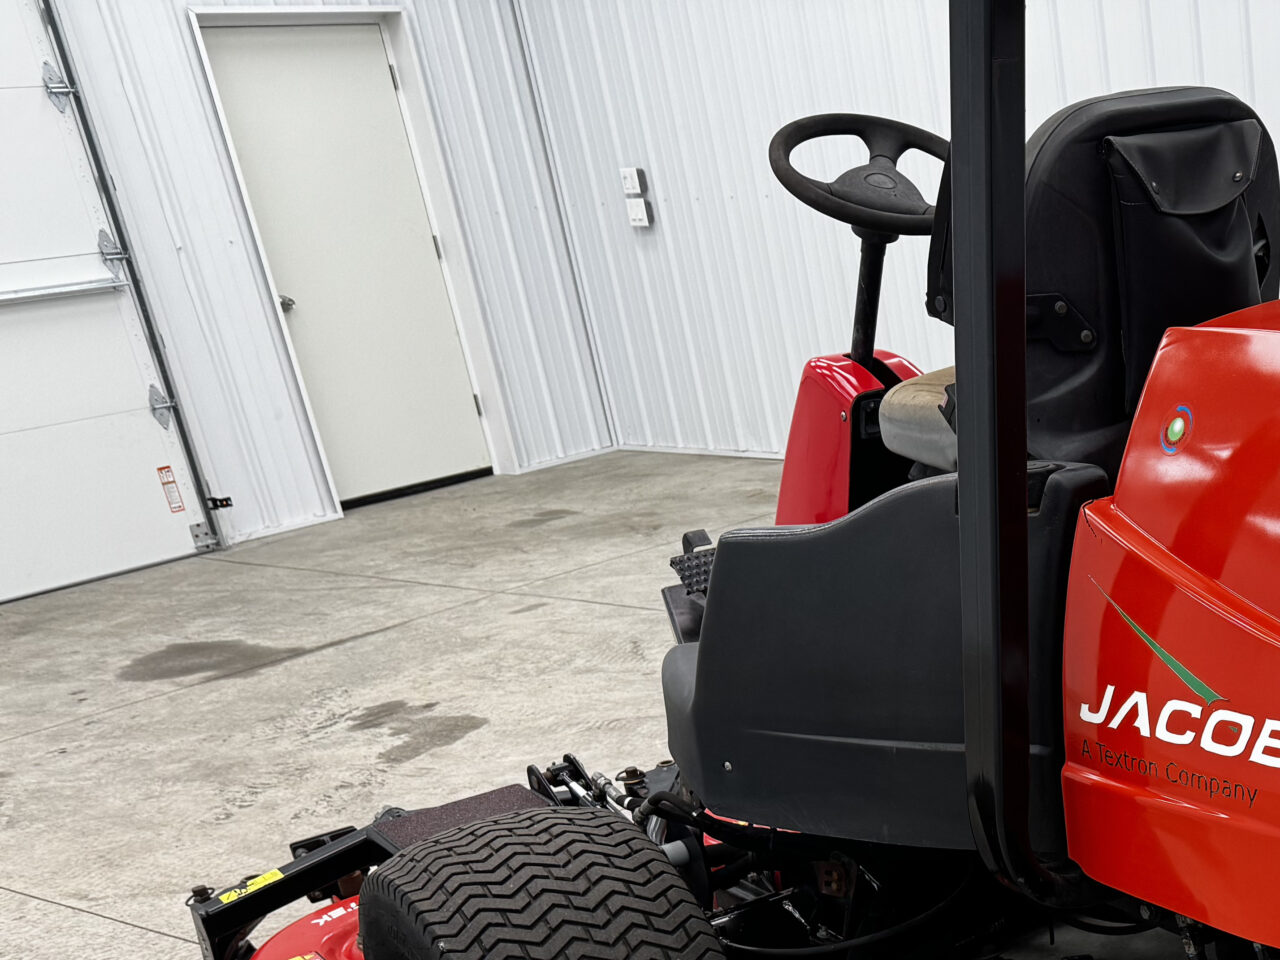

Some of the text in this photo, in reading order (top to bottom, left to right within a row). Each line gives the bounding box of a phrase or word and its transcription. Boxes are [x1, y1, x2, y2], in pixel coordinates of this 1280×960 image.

[1081, 739, 1259, 808] A Textron Company
